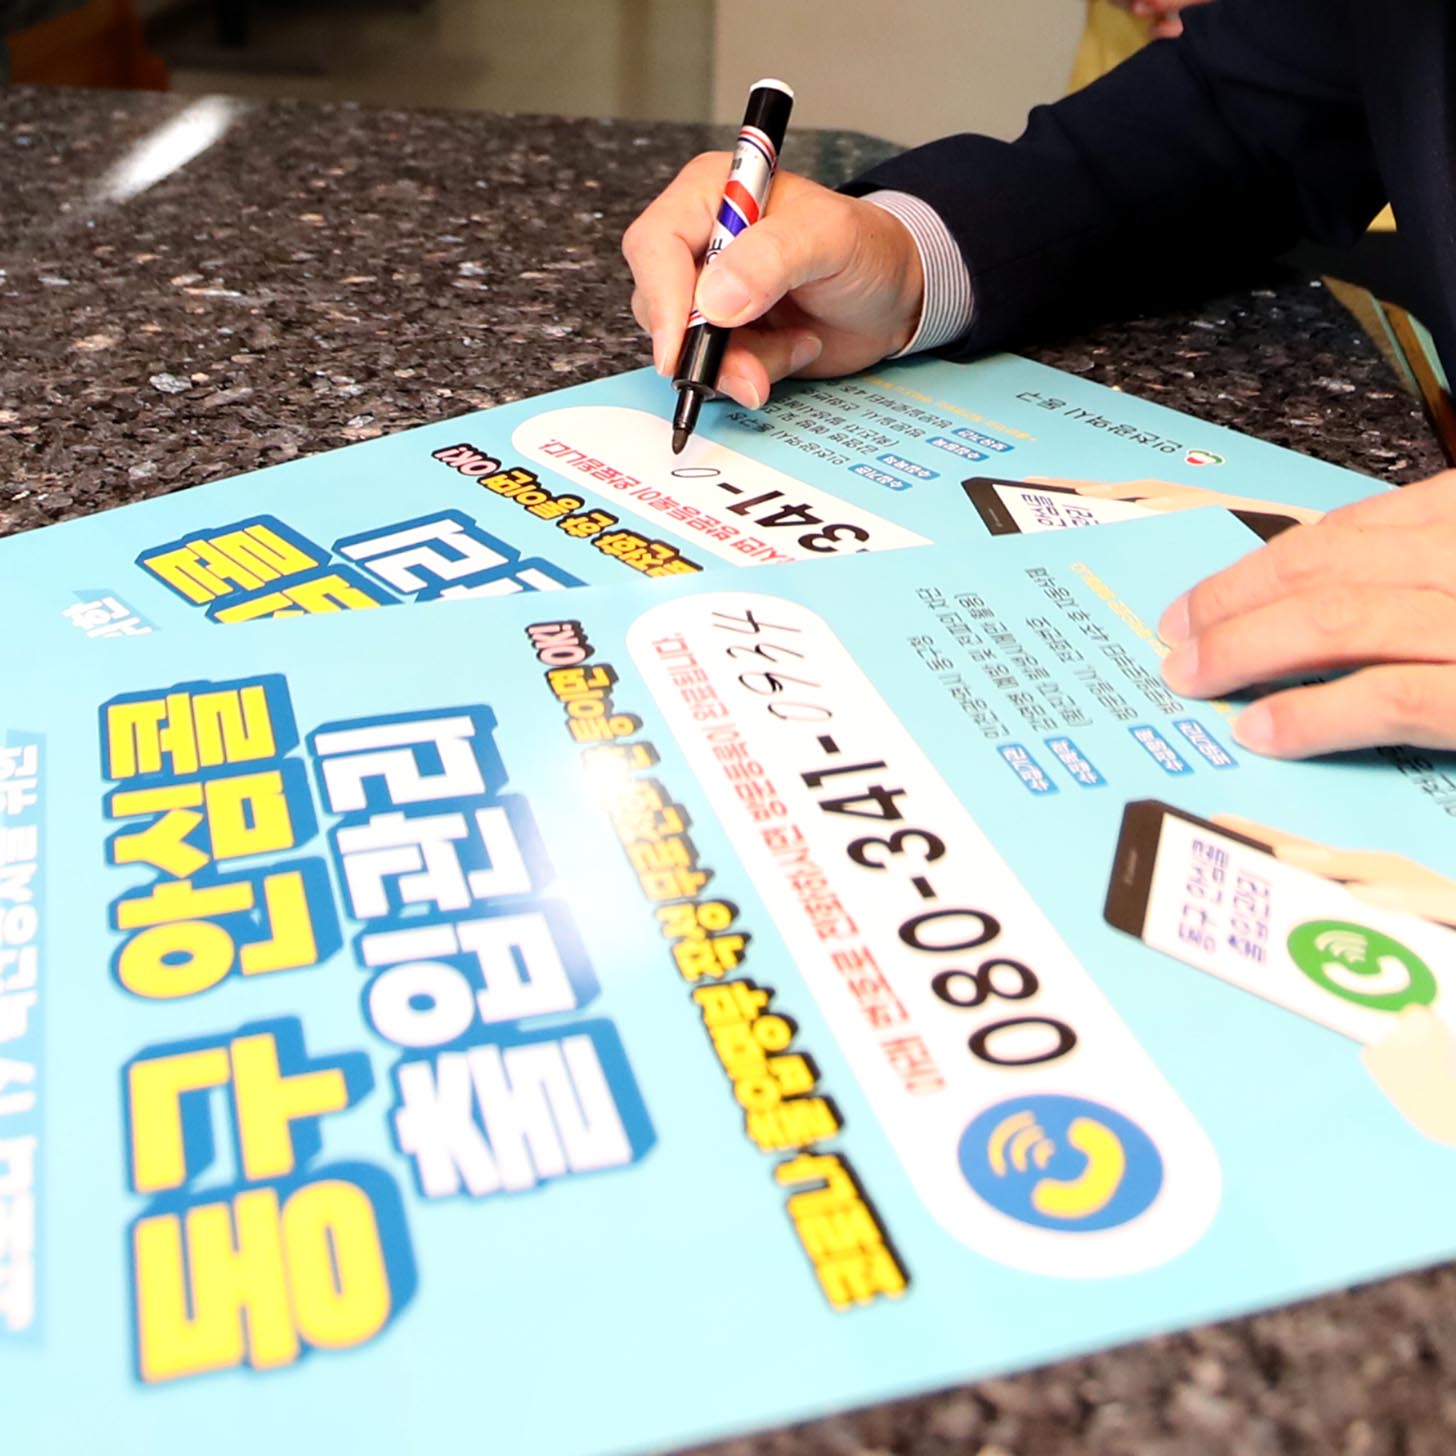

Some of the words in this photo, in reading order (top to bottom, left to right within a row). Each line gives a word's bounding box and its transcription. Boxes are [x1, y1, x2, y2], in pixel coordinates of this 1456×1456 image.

[869, 394, 953, 428] 방문일로부터
[1015, 391, 1067, 410] 동구
[769, 428, 850, 465] 인천광역시
[798, 419, 831, 437] 예방
[827, 433, 880, 455] 감염병
[843, 418, 900, 448] (확진자
[1064, 407, 1183, 453] 인천광역시
[432, 443, 501, 477] OK!
[537, 439, 641, 489] 완료됩니다.
[480, 468, 585, 520] 통이면
[631, 488, 738, 541] 방문등록이
[557, 508, 618, 540] 한
[731, 536, 796, 564] 시면
[915, 587, 950, 611] 차단
[954, 591, 994, 620] 활용)
[1025, 566, 1080, 610] 자동삭제
[525, 619, 594, 668] OK!
[908, 634, 955, 672] 동구청
[936, 611, 984, 646] 전파의
[983, 622, 1050, 682] 발생시에만
[1025, 616, 1085, 664] 전화번호
[1082, 624, 1111, 643] 4주
[652, 632, 729, 722] 완료됩니다.
[970, 648, 997, 664] 및
[982, 663, 1020, 690] 예방
[1099, 643, 1184, 715] 방문일로부터
[546, 663, 643, 743] 통이면
[938, 673, 1011, 740] 인천광역시
[1007, 691, 1059, 732] 감염병
[1036, 682, 1093, 728] (확진자
[702, 723, 788, 822] 방문등록이
[104, 683, 320, 1000] 안심콜
[760, 824, 860, 942] 전화하시면
[1186, 839, 1230, 905] 안심콜
[655, 900, 752, 982] 작성
[1178, 903, 1217, 953] 동구
[1227, 870, 1273, 964] 출입관리
[312, 713, 635, 1201] 출입관리
[830, 945, 911, 1030] 번호로
[691, 978, 844, 1153] 출입명부
[881, 1035, 947, 1096] 아래
[126, 1030, 394, 1386] 동구
[773, 1151, 910, 1312] 코로나
